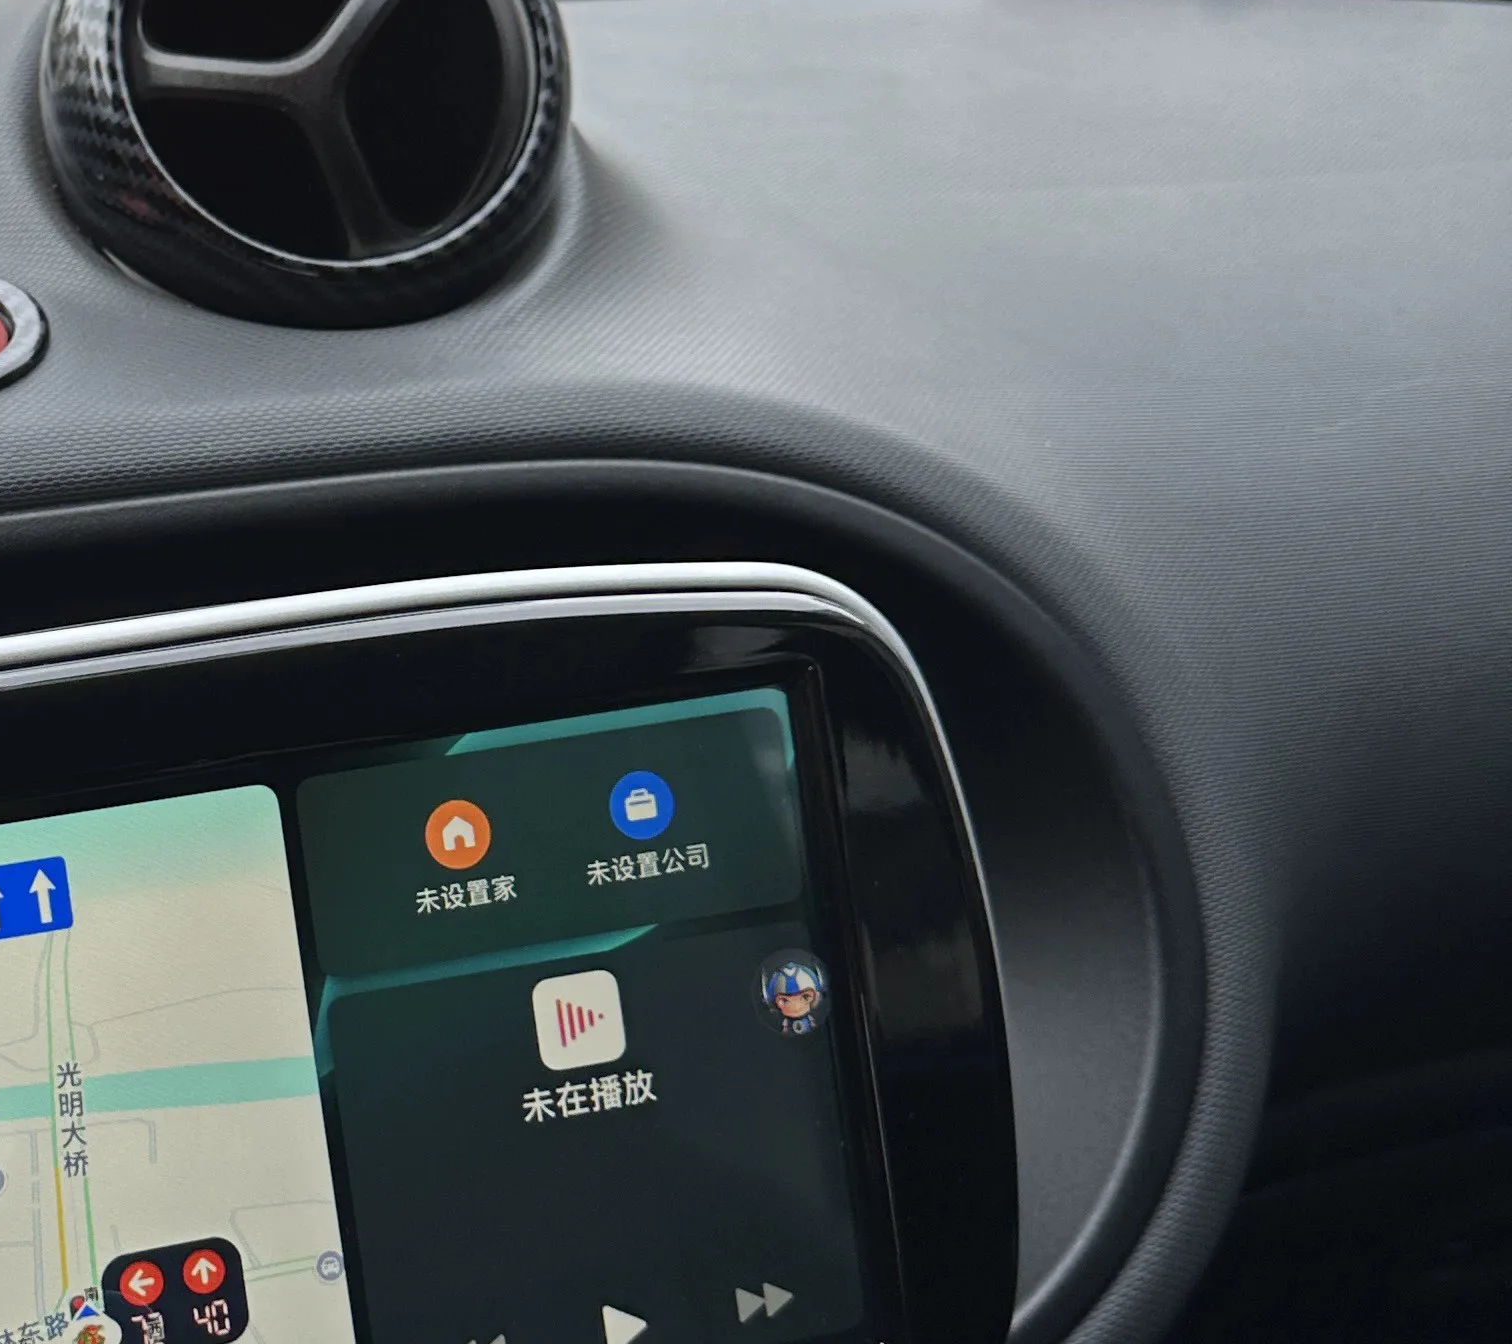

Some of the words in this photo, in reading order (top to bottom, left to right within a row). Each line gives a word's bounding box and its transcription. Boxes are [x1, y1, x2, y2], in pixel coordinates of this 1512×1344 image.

[587, 842, 710, 886] 未设置公司
[416, 874, 518, 915] 未设置家
[522, 1068, 658, 1123] 未在播放
[56, 1061, 89, 1178] 光明大桥
[193, 1298, 231, 1337] 40
